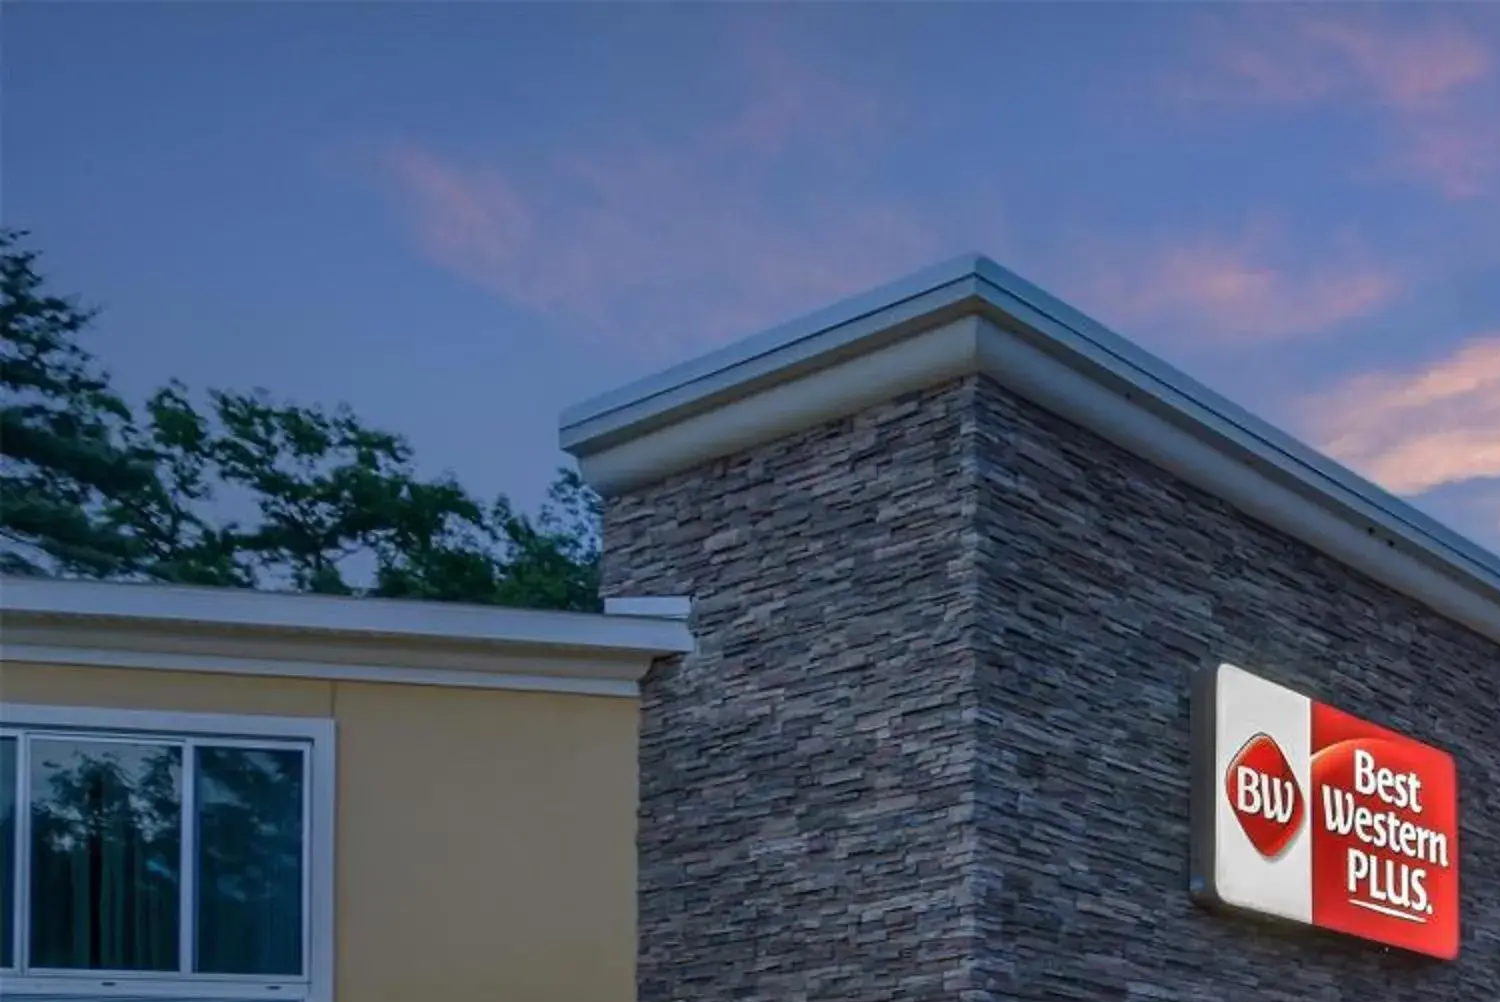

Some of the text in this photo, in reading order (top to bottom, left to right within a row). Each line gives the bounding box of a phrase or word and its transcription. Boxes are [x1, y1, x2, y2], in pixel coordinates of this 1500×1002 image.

[1237, 765, 1295, 824] BW
[1354, 749, 1423, 813] Best
[1321, 784, 1449, 867] Western
